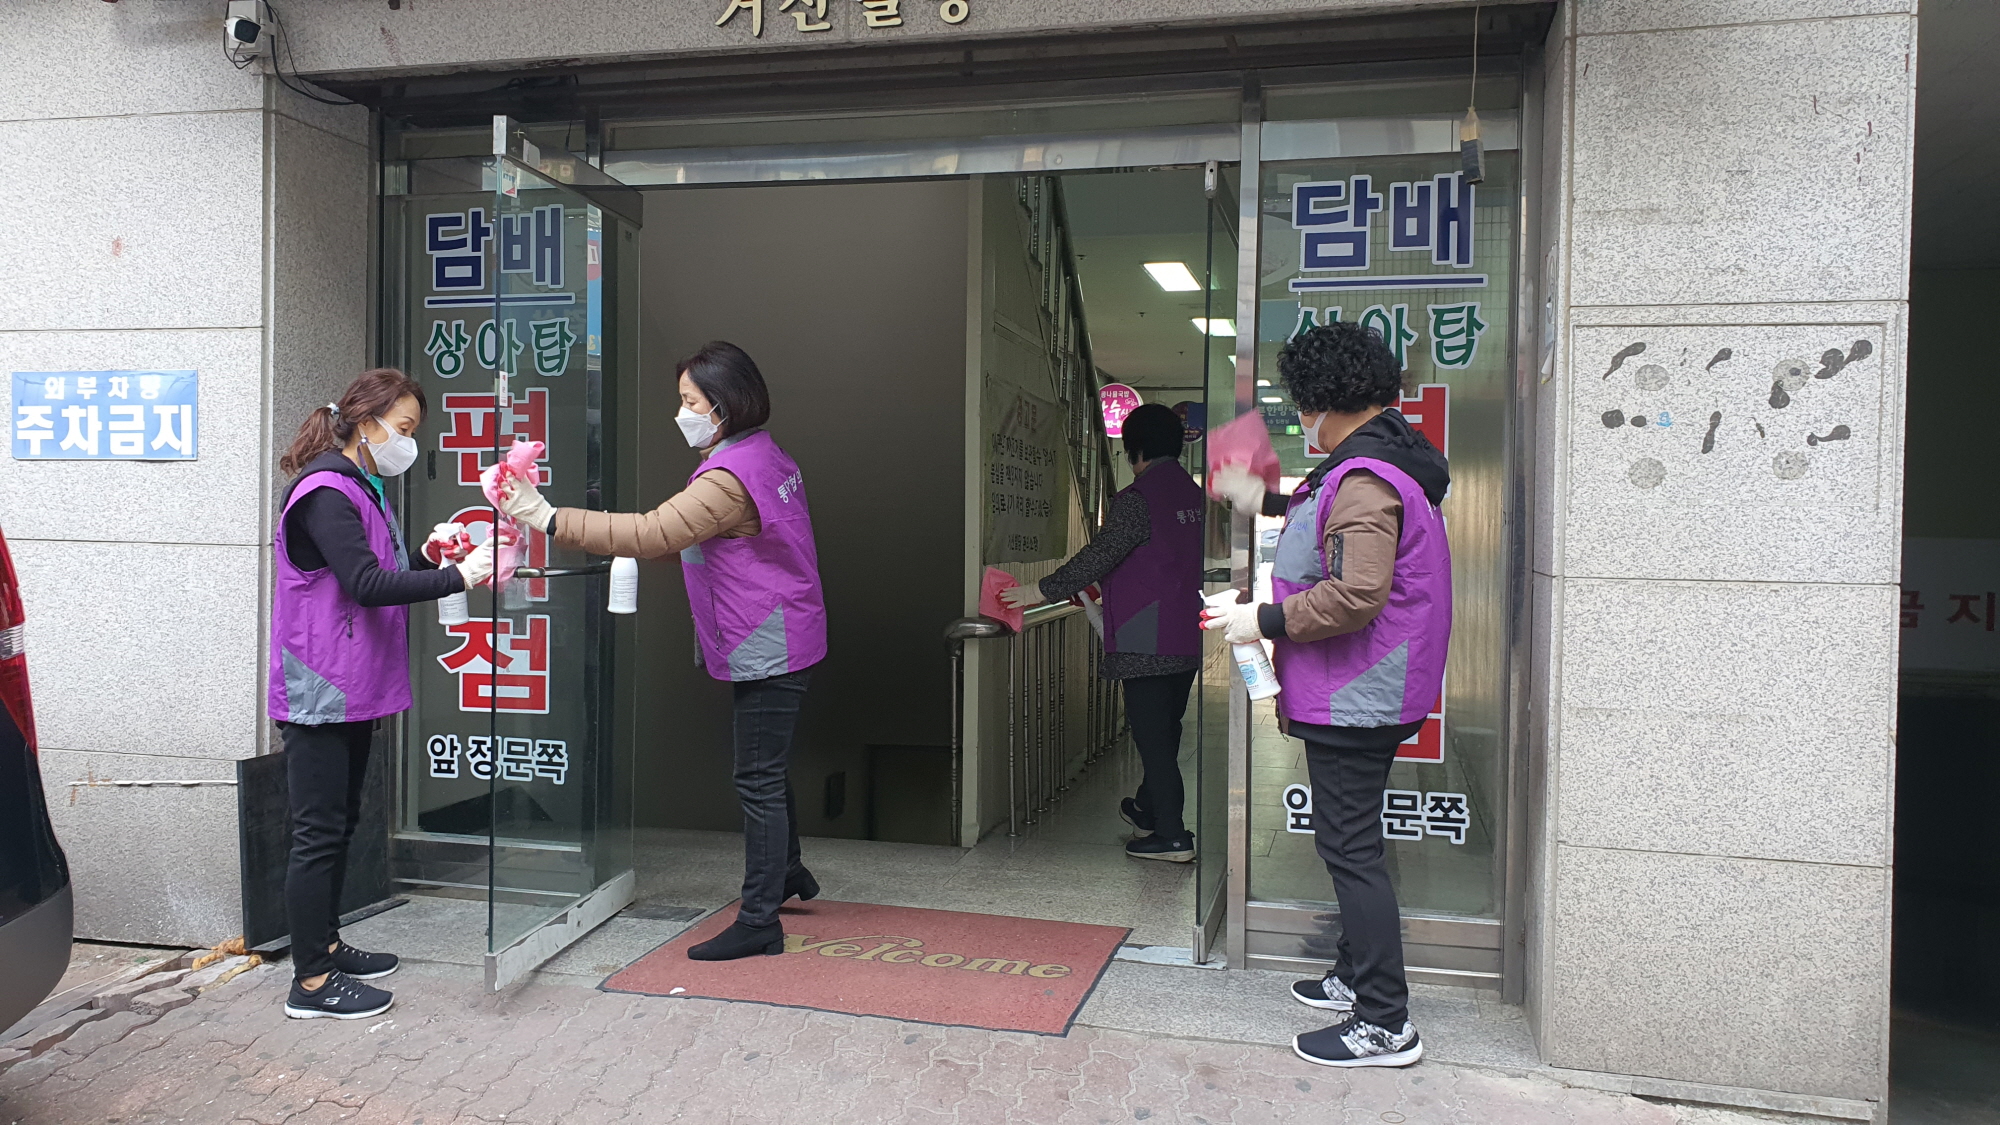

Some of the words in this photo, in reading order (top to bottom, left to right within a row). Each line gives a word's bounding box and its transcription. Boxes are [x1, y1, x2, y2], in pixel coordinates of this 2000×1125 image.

[426, 204, 565, 290] 담배
[1292, 171, 1476, 272] 담배
[424, 318, 577, 379] 상아탑
[44, 375, 162, 400] 외부차량
[15, 404, 193, 456] 주차금지
[427, 734, 462, 779] 앞
[466, 735, 568, 785] 정문쪽
